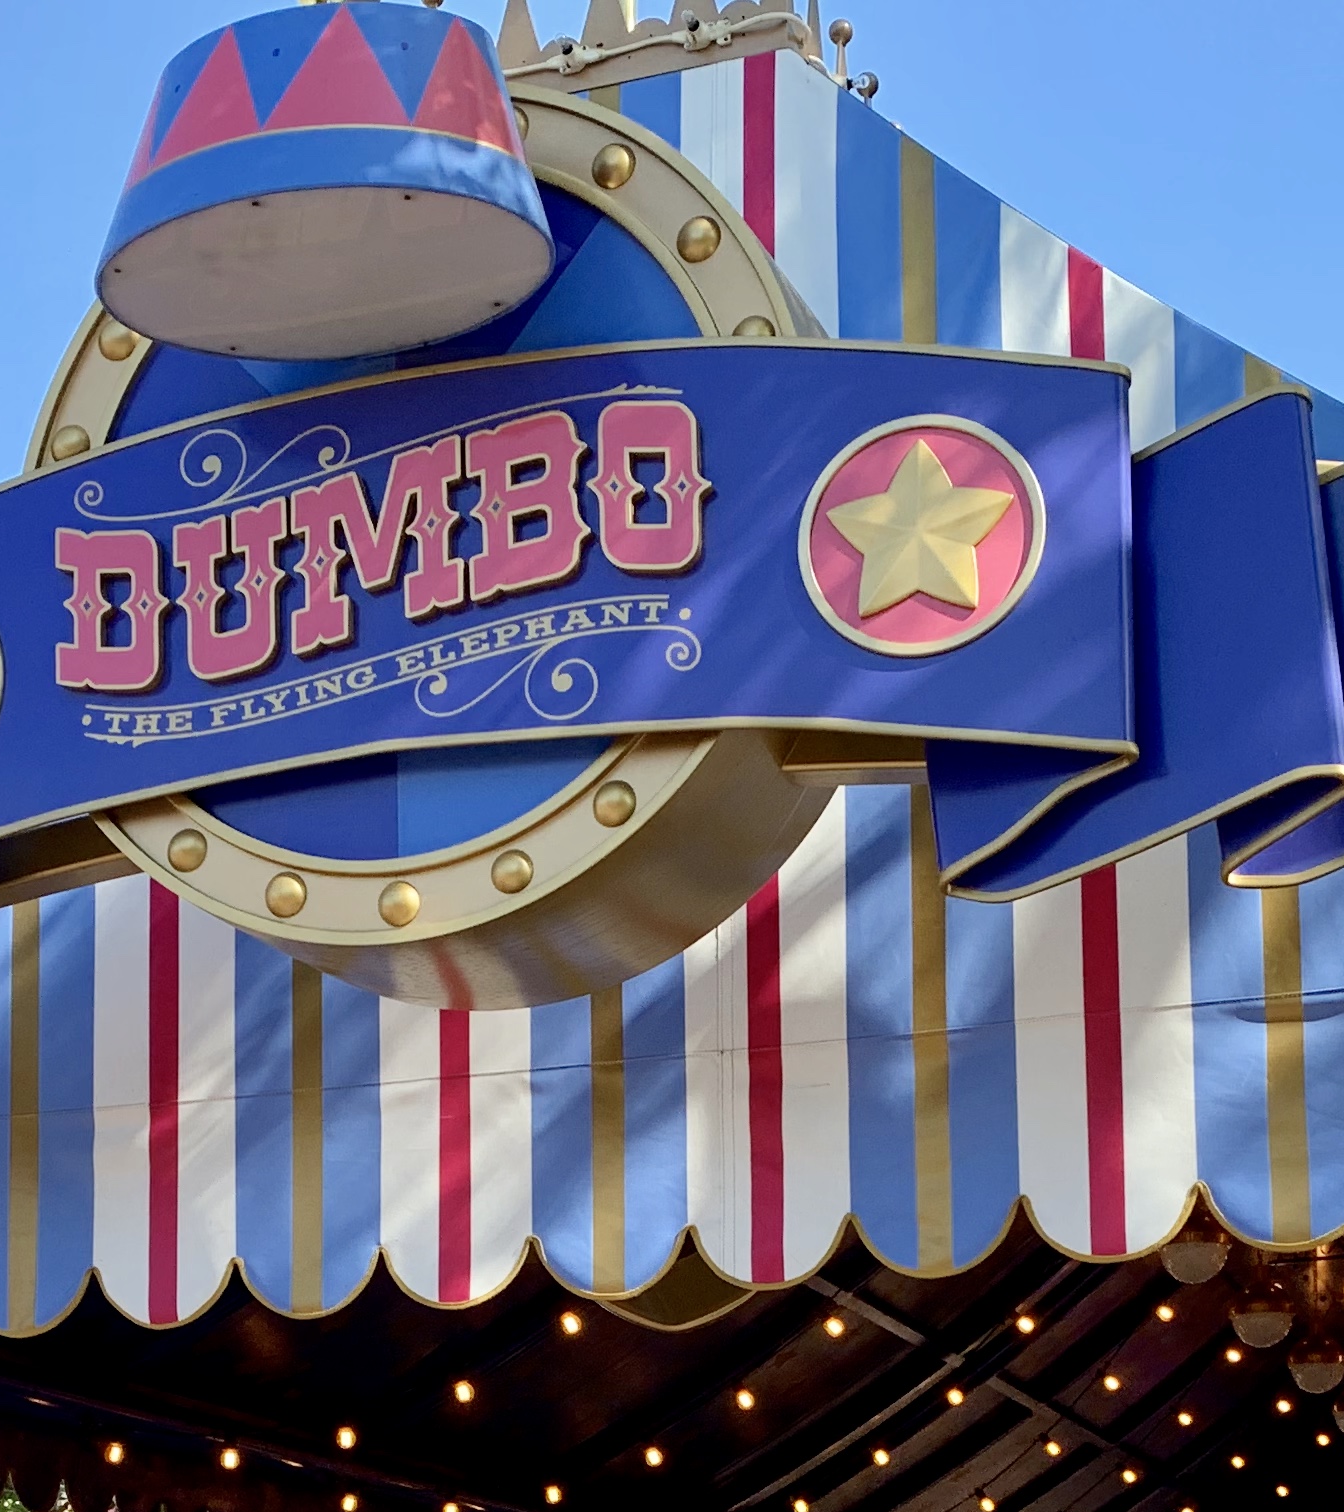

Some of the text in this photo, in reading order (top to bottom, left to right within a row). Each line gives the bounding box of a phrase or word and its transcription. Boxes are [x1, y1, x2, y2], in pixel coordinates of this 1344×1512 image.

[55, 400, 713, 691] DUMBO
[104, 601, 669, 735] THE FLYING ELEPHANT
